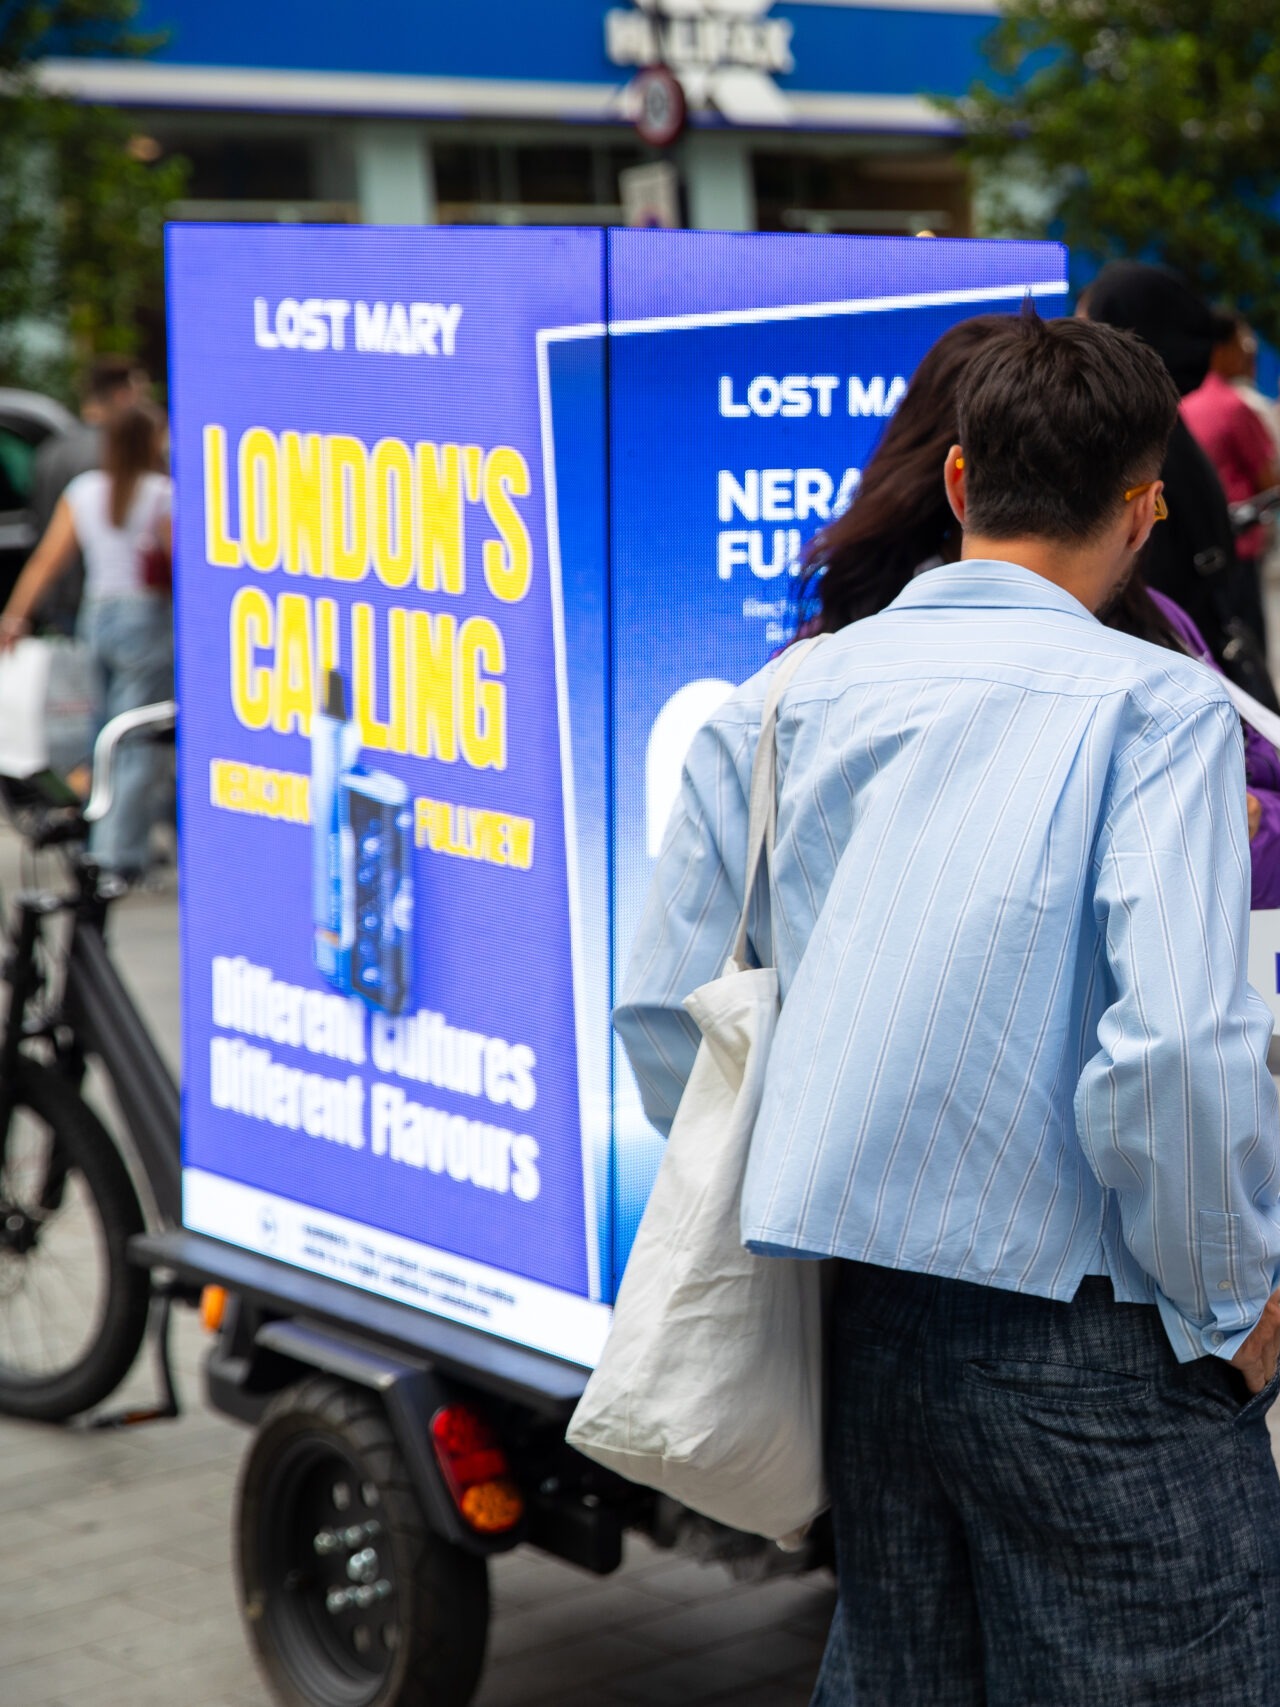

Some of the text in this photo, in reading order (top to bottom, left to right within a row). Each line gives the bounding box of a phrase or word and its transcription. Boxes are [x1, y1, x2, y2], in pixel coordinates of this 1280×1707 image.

[253, 297, 463, 356] LOST MARY
[720, 375, 838, 417] LOST
[203, 424, 533, 603] LONDON'S
[229, 585, 508, 771] CALLING
[212, 955, 537, 1112] Different Cultures
[210, 1036, 541, 1203] Different Flavours
